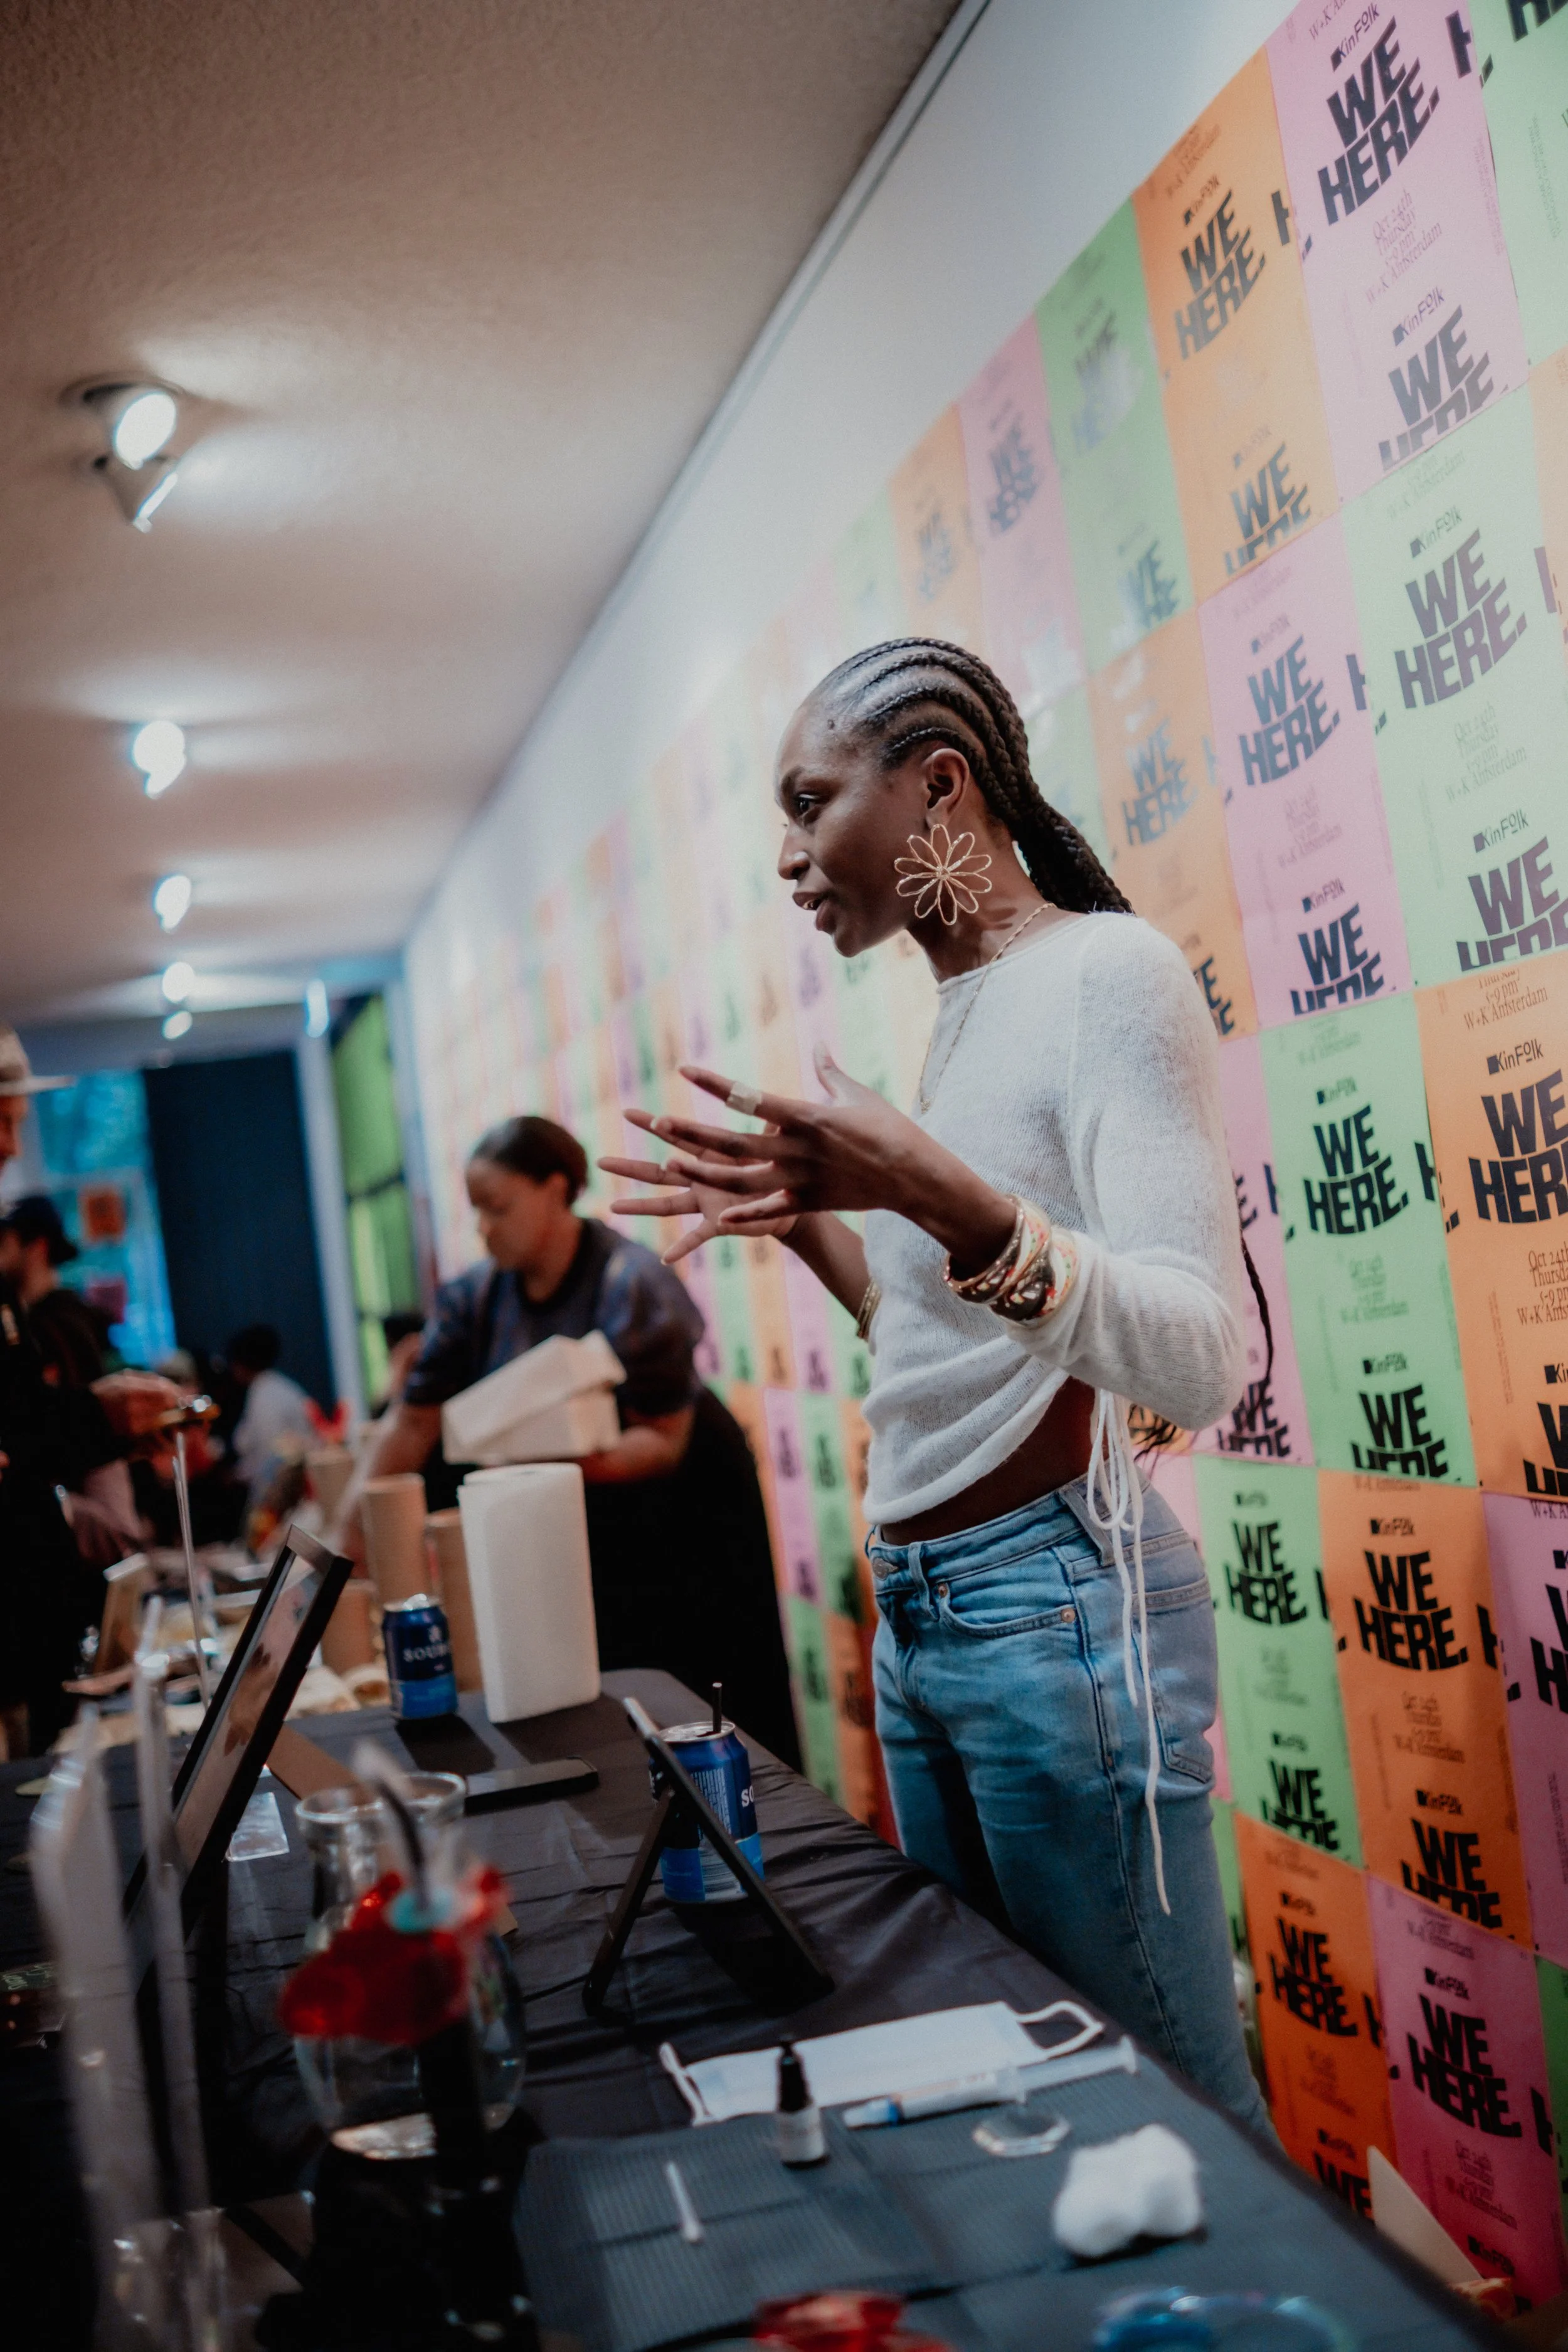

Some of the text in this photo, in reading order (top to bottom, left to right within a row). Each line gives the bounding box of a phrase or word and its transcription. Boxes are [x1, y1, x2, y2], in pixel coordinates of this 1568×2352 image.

[1327, 16, 1407, 149] WE
[1318, 57, 1439, 226] HERE.
[1181, 189, 1240, 295] WE
[1388, 304, 1474, 426] WE
[1230, 442, 1296, 539] WE
[1405, 527, 1491, 639] WE
[1248, 635, 1312, 725] WE
[1394, 578, 1527, 709] HERE.
[1239, 679, 1340, 786] HERE.
[1467, 836, 1560, 936] WE
[1297, 902, 1368, 985] WE
[1491, 987, 1548, 1022] Amsterdam
[1313, 1104, 1379, 1177] WE
[1481, 1068, 1568, 1157] WE
[1468, 1140, 1568, 1224] HER
[1517, 1305, 1543, 1325] W+K
[1359, 1384, 1432, 1448] WE
[1232, 1518, 1285, 1572] WE
[1364, 1550, 1438, 1611] WE
[1353, 1596, 1469, 1671] HERE.
[1270, 1757, 1326, 1819] WE
[1411, 1818, 1486, 1892] WE
[1278, 1915, 1333, 1983] WE
[1419, 1993, 1493, 2076] WE
